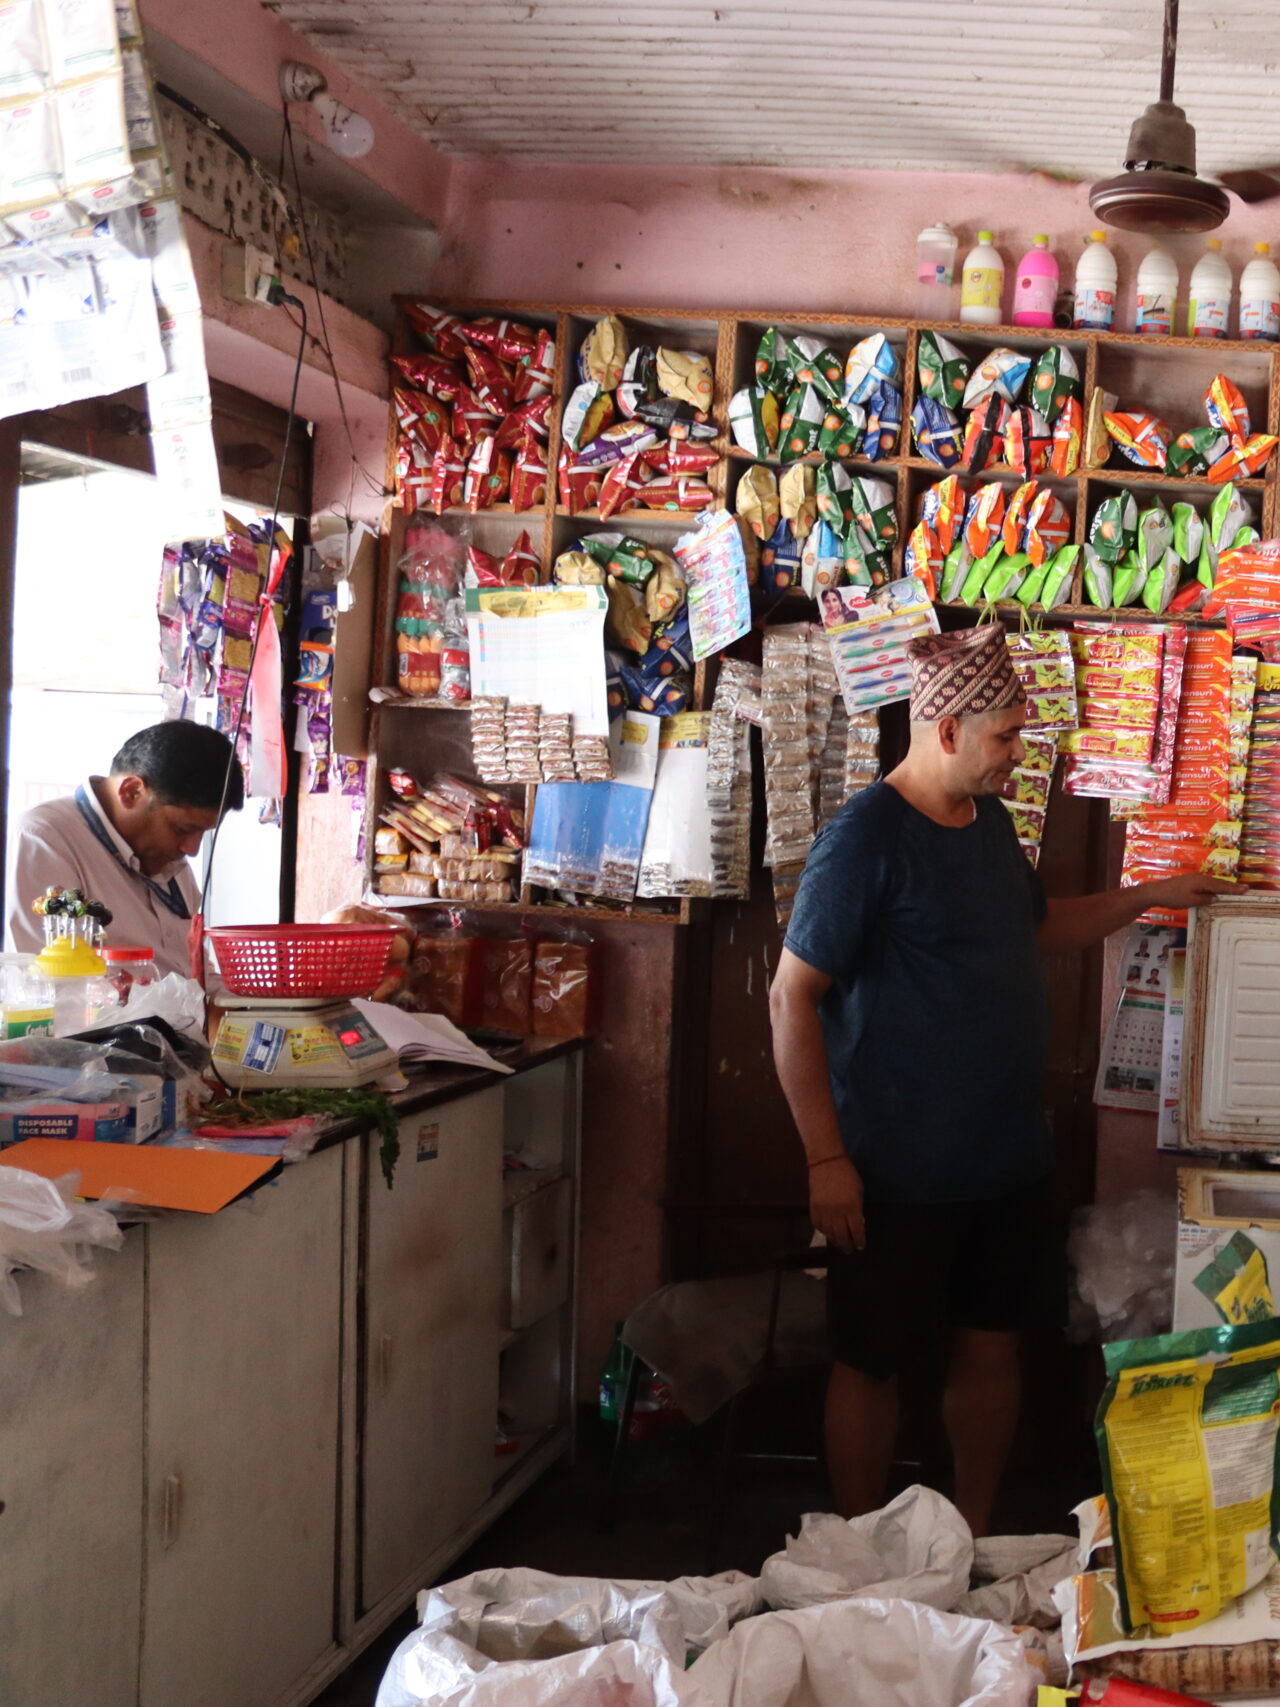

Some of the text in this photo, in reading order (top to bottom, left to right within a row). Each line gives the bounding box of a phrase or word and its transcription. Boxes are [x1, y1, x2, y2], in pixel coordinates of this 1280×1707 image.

[1176, 770, 1210, 779] Bansuri
[1175, 798, 1210, 807] Bansuri
[18, 1119, 74, 1127] DISPOSABLE
